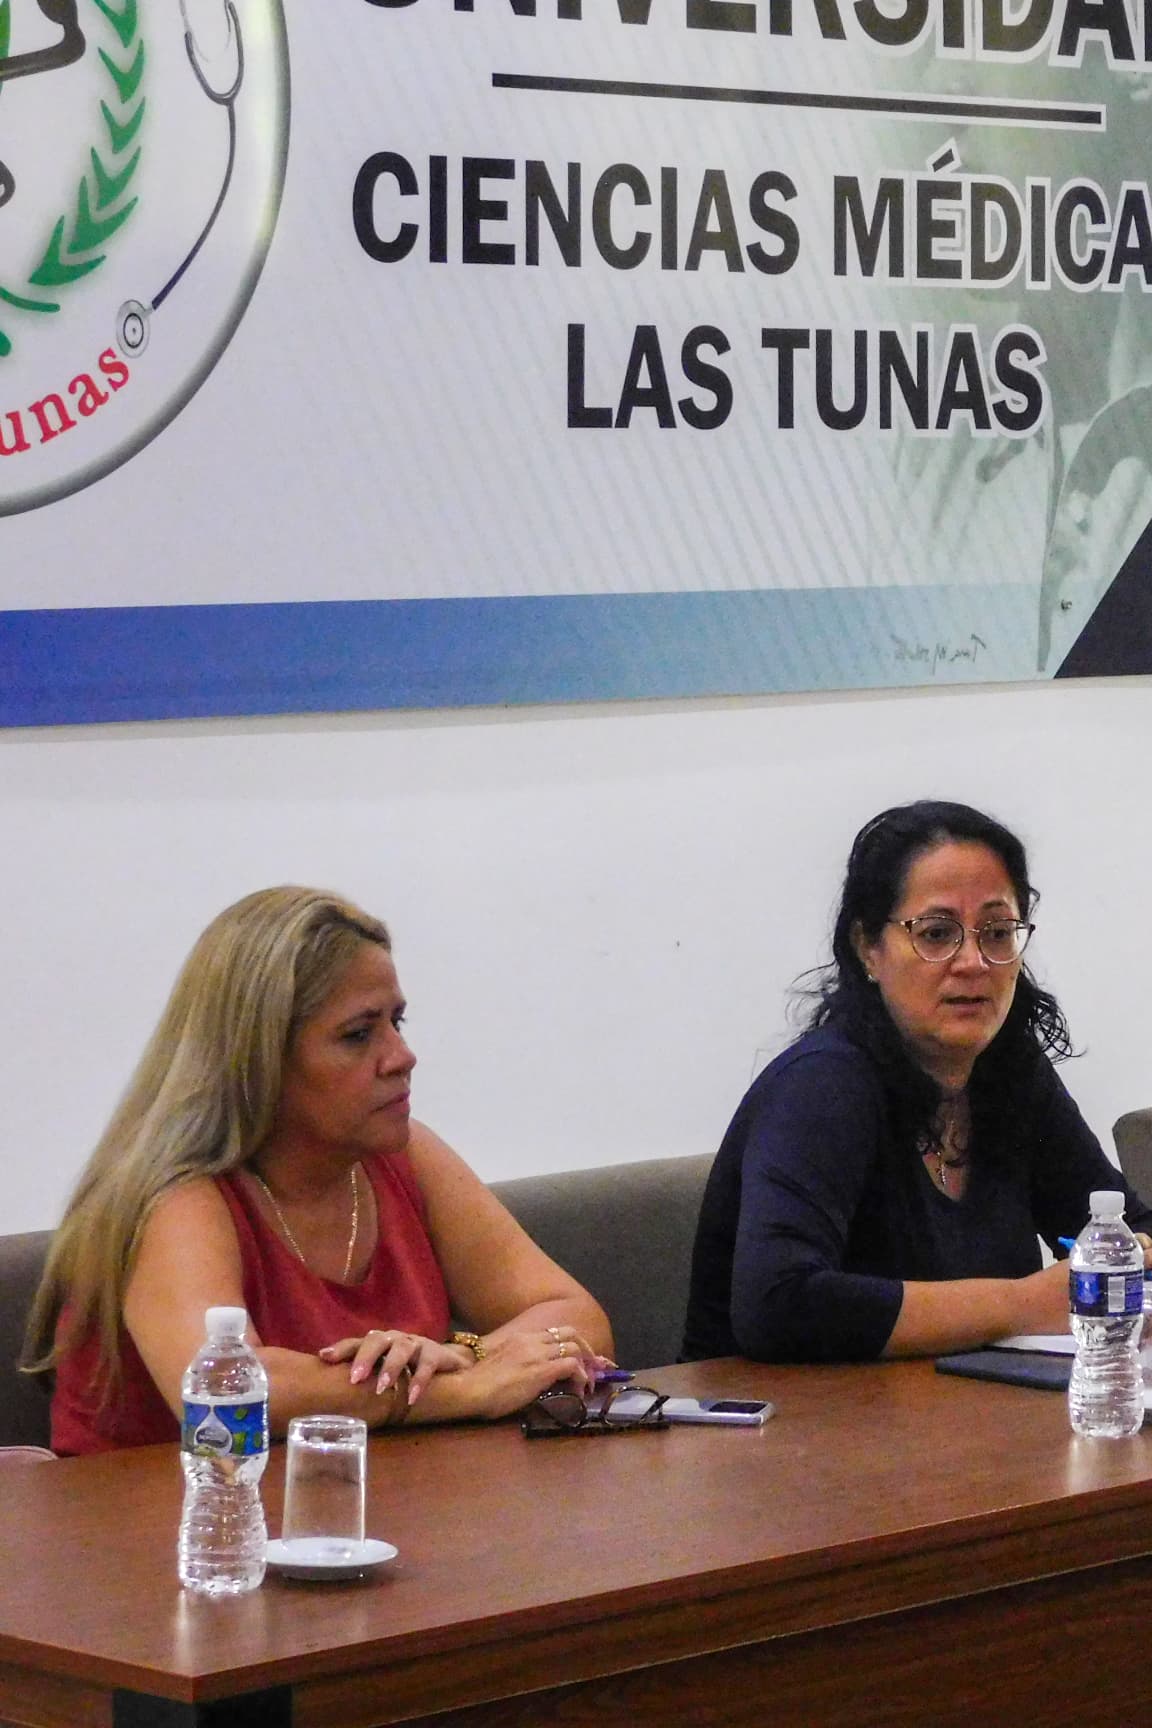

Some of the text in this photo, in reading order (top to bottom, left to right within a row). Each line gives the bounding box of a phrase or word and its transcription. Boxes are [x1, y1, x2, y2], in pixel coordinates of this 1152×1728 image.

[352, 151, 800, 275] CIENCIAS
[567, 323, 1043, 432] LAS TUNAS
